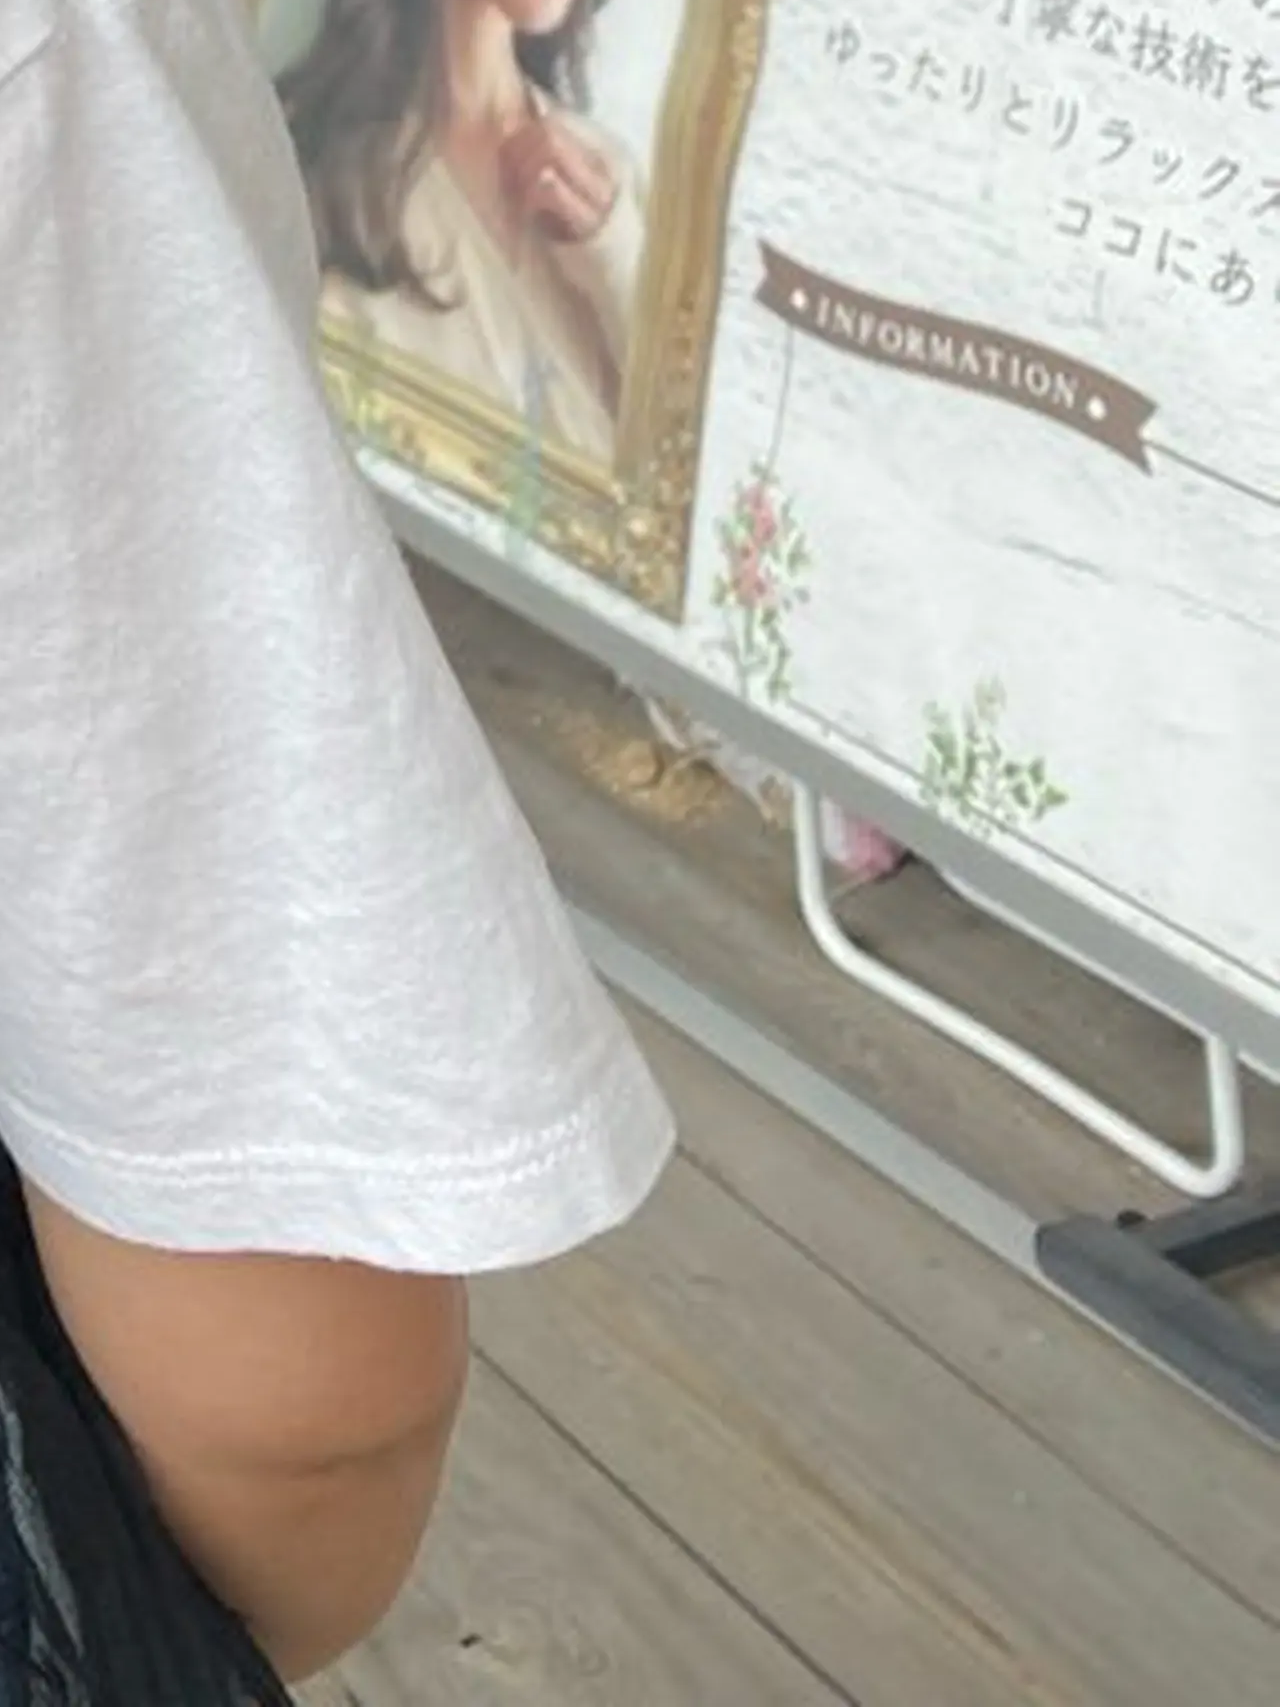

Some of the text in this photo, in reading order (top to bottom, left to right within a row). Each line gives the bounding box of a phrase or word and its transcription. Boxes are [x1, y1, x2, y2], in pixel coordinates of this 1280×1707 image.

[1054, 197, 1280, 307] ココにあ
[815, 293, 1080, 410] INFORMATION
